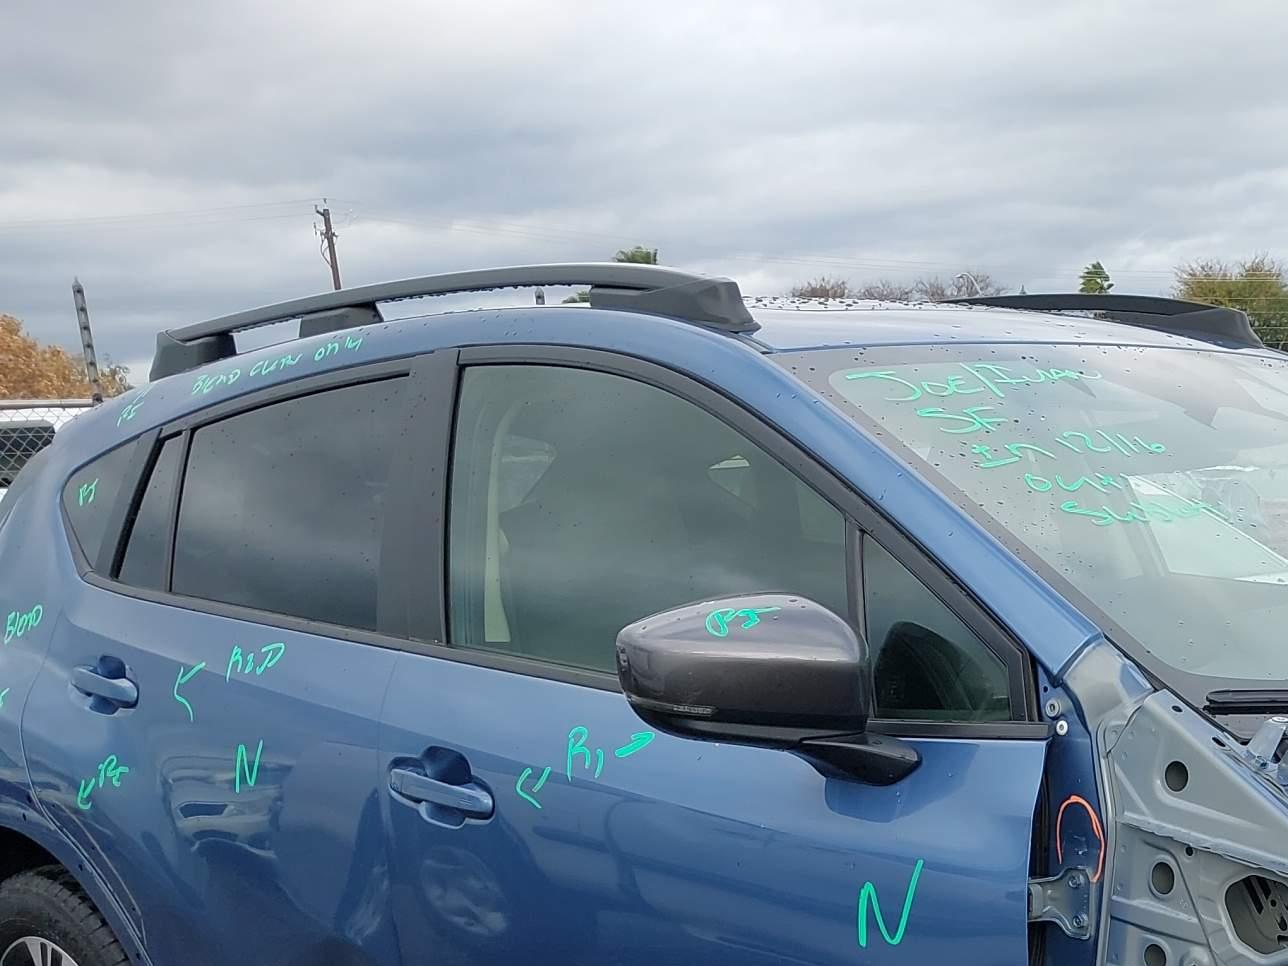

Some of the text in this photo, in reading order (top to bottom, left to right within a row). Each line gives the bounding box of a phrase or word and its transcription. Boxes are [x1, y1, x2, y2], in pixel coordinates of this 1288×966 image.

[917, 406, 1008, 434] SF
[1055, 429, 1167, 459] 12/16
[234, 738, 265, 794] N
[856, 858, 925, 948] N
